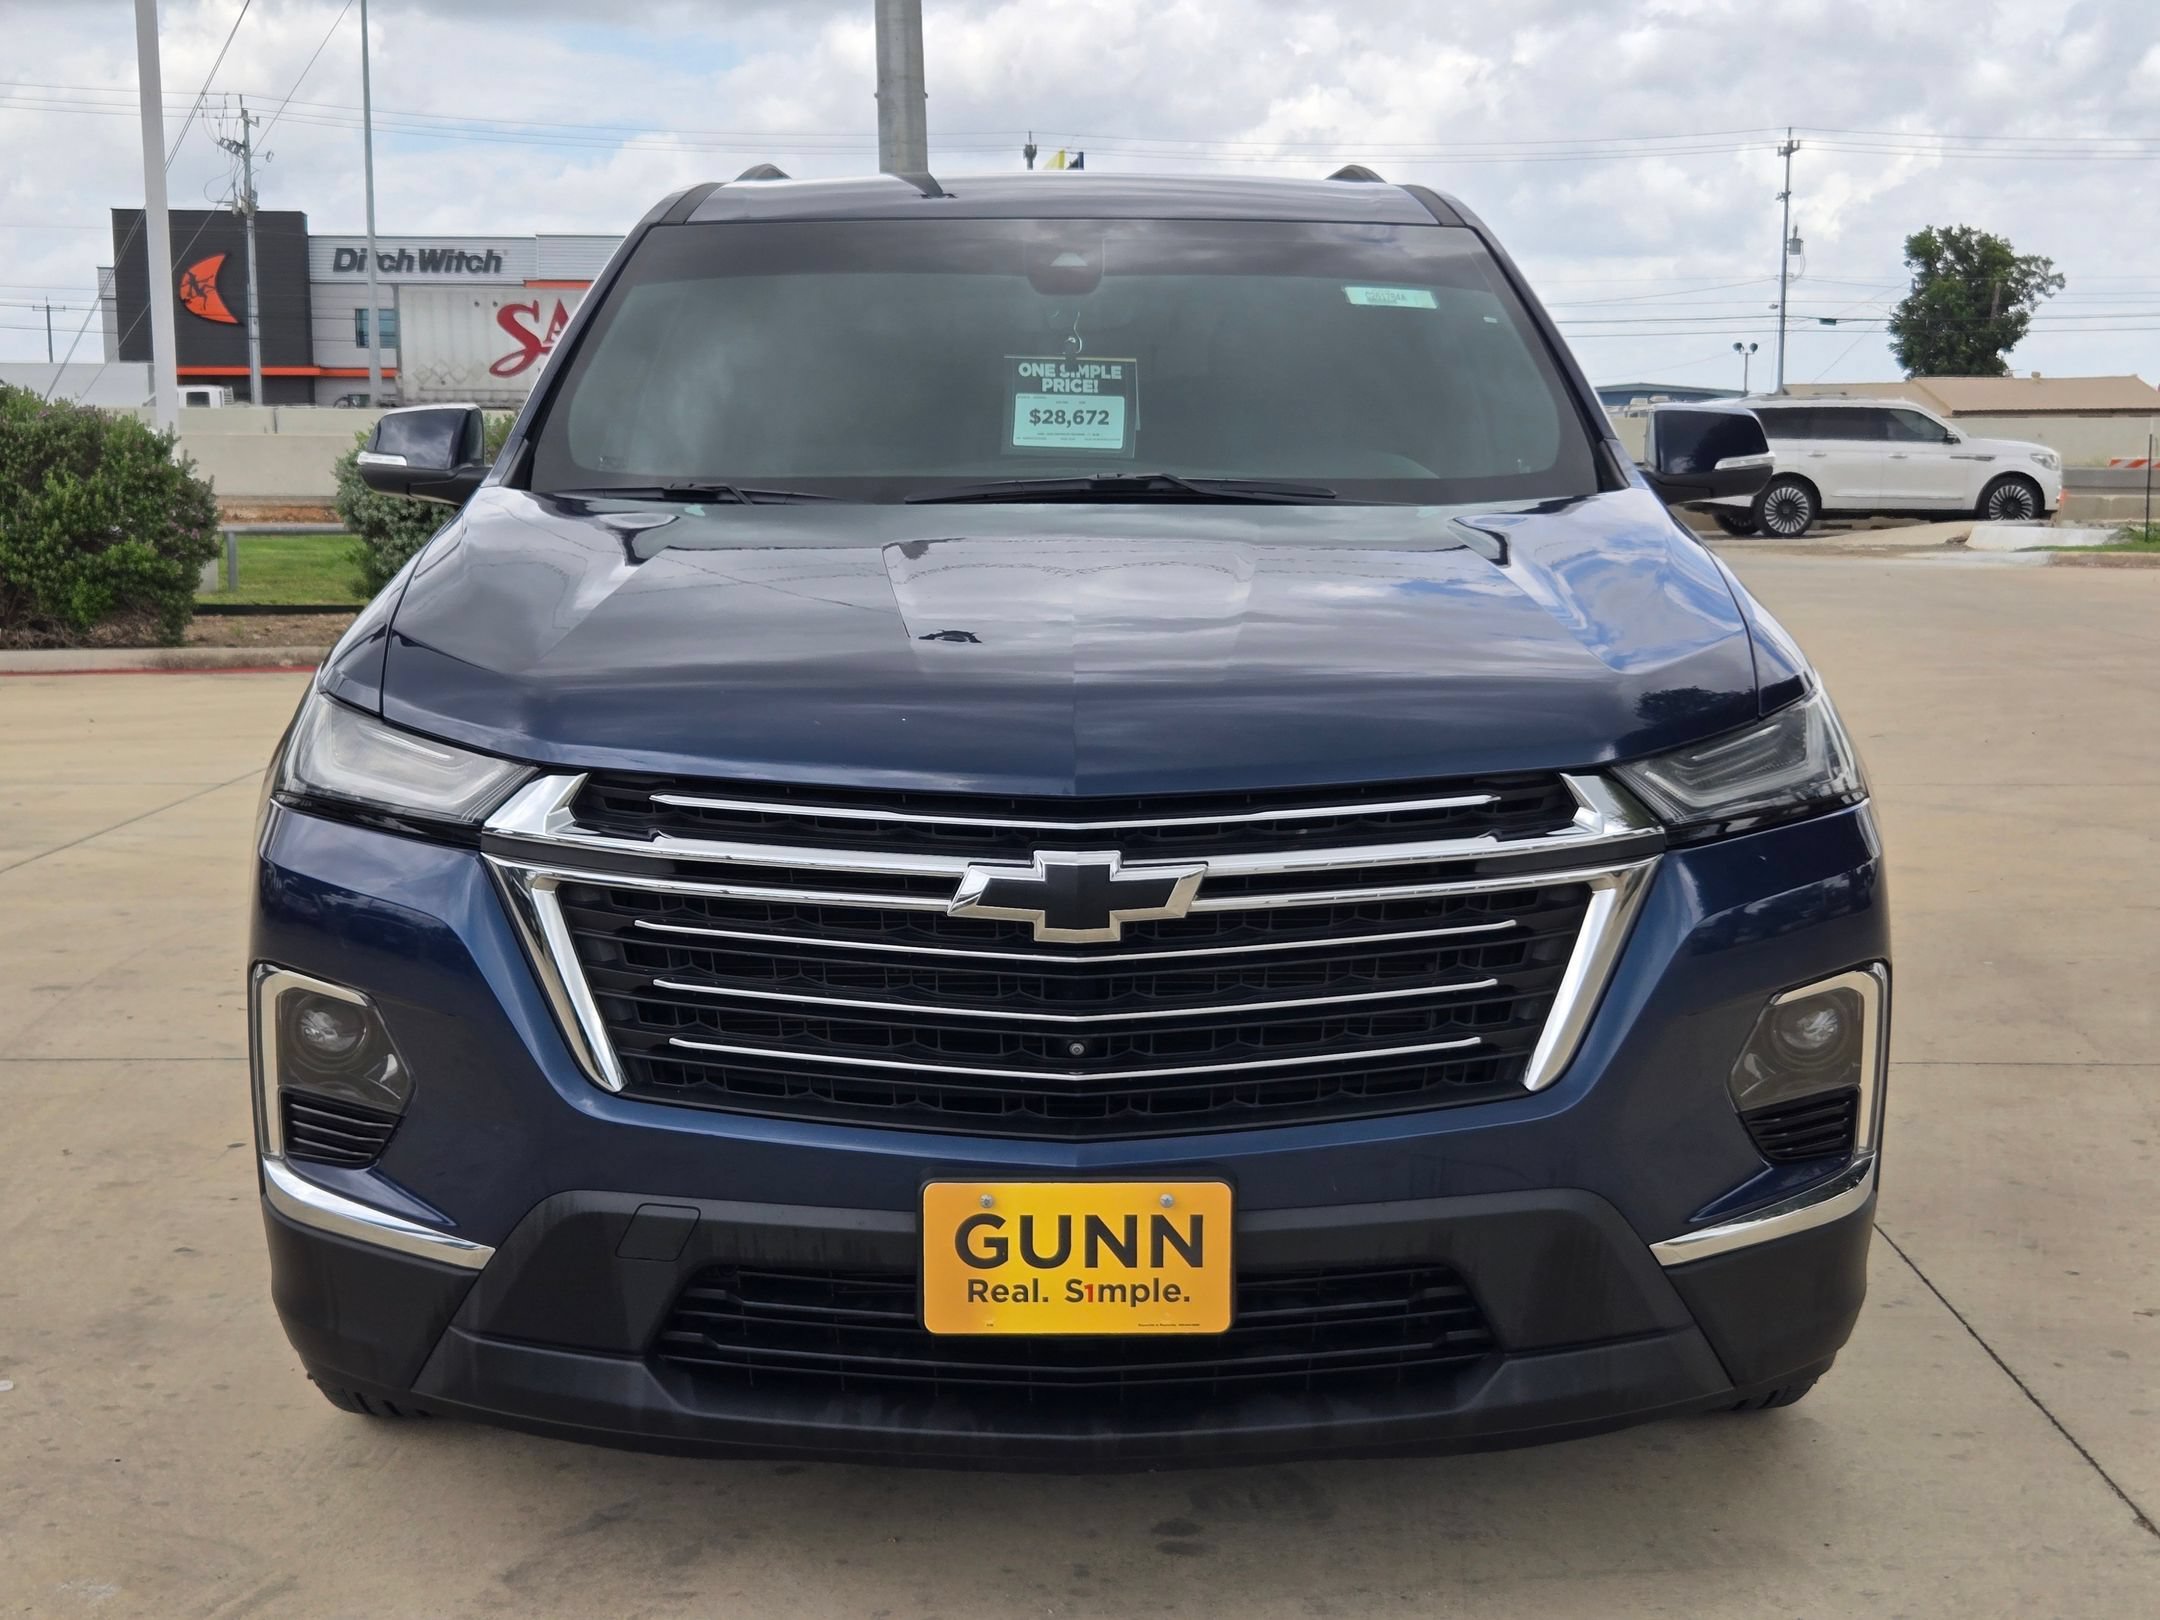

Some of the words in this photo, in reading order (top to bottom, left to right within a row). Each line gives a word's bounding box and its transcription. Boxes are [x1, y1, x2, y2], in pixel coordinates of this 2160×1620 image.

[418, 248, 503, 274] Witch
[1018, 362, 1056, 378] ONE
[1060, 363, 1122, 380] SMPLE
[1042, 378, 1099, 393] PRICE!
[1029, 408, 1110, 428] $28,672
[954, 1212, 1203, 1269] GUNN
[967, 1277, 1049, 1303] Real.
[1064, 1277, 1190, 1307] S1mple.
